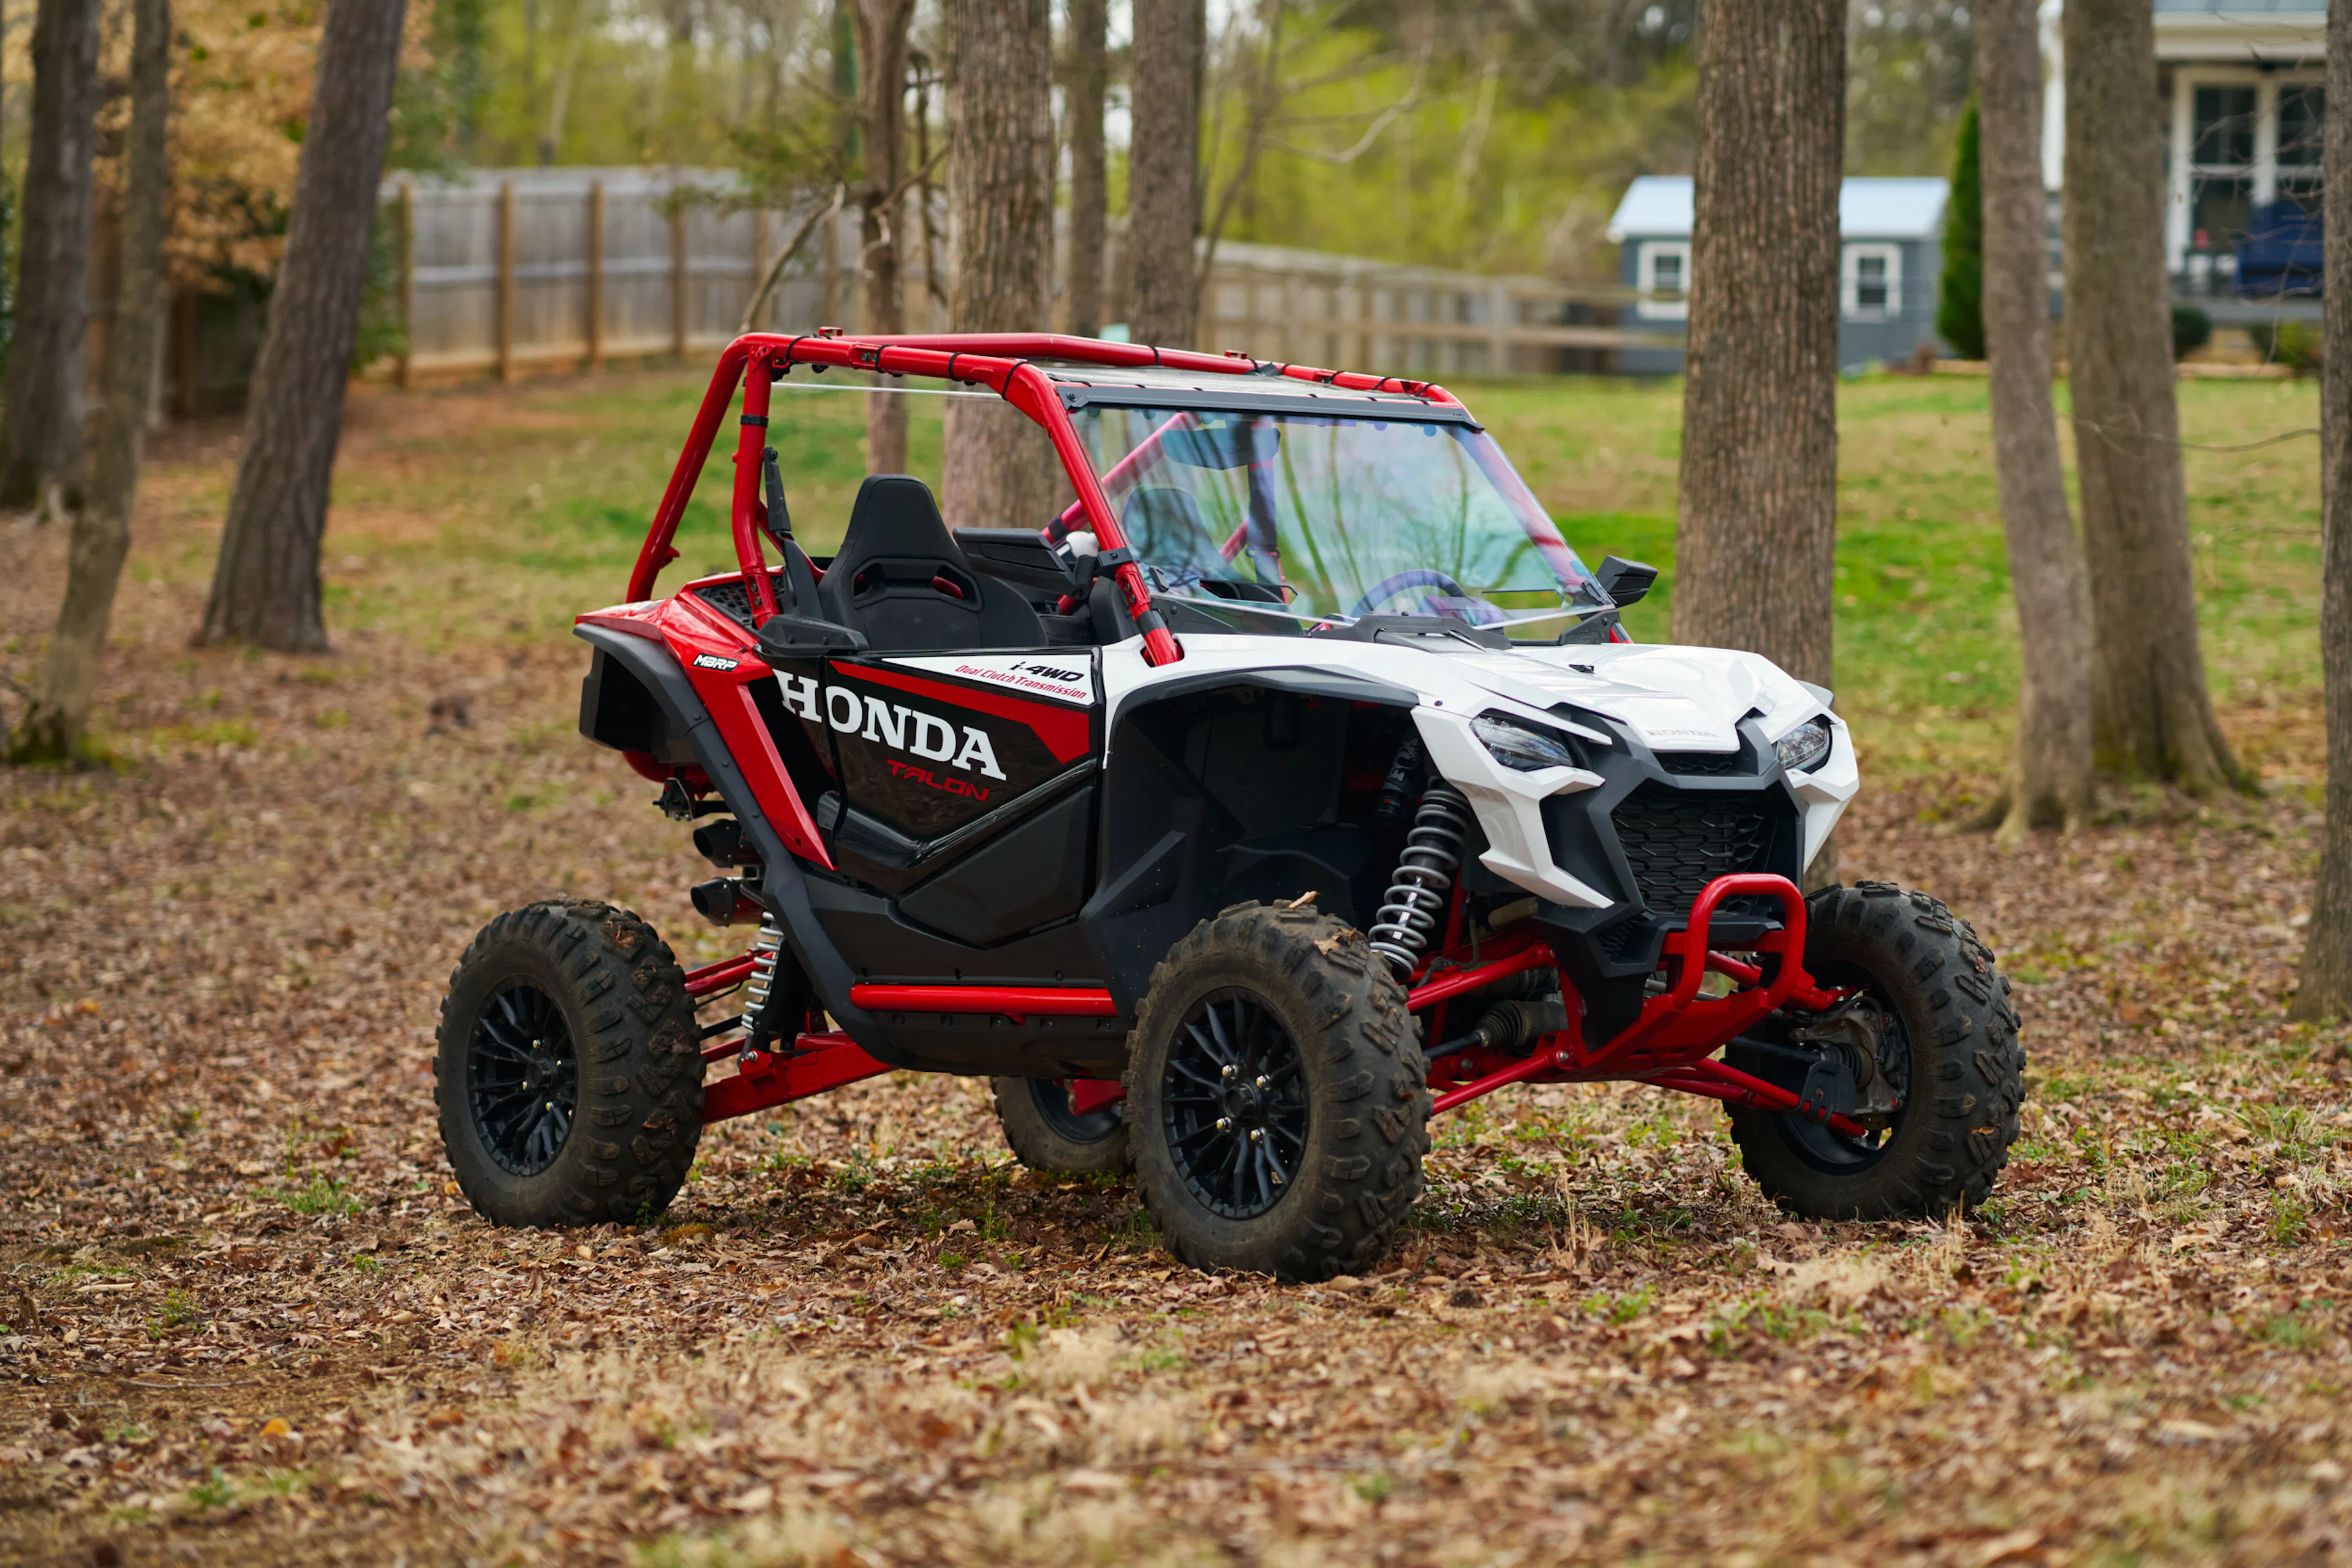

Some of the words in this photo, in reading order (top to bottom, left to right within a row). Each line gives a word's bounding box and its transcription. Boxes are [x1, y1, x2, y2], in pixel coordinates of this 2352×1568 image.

[693, 654, 737, 670] MBRP
[1009, 662, 1084, 682] i-4WD
[955, 665, 982, 675] Dual
[980, 669, 1016, 683] Clutch
[1015, 676, 1087, 699] Transmission
[772, 668, 1007, 781] HONDA
[886, 760, 990, 802] TALON
